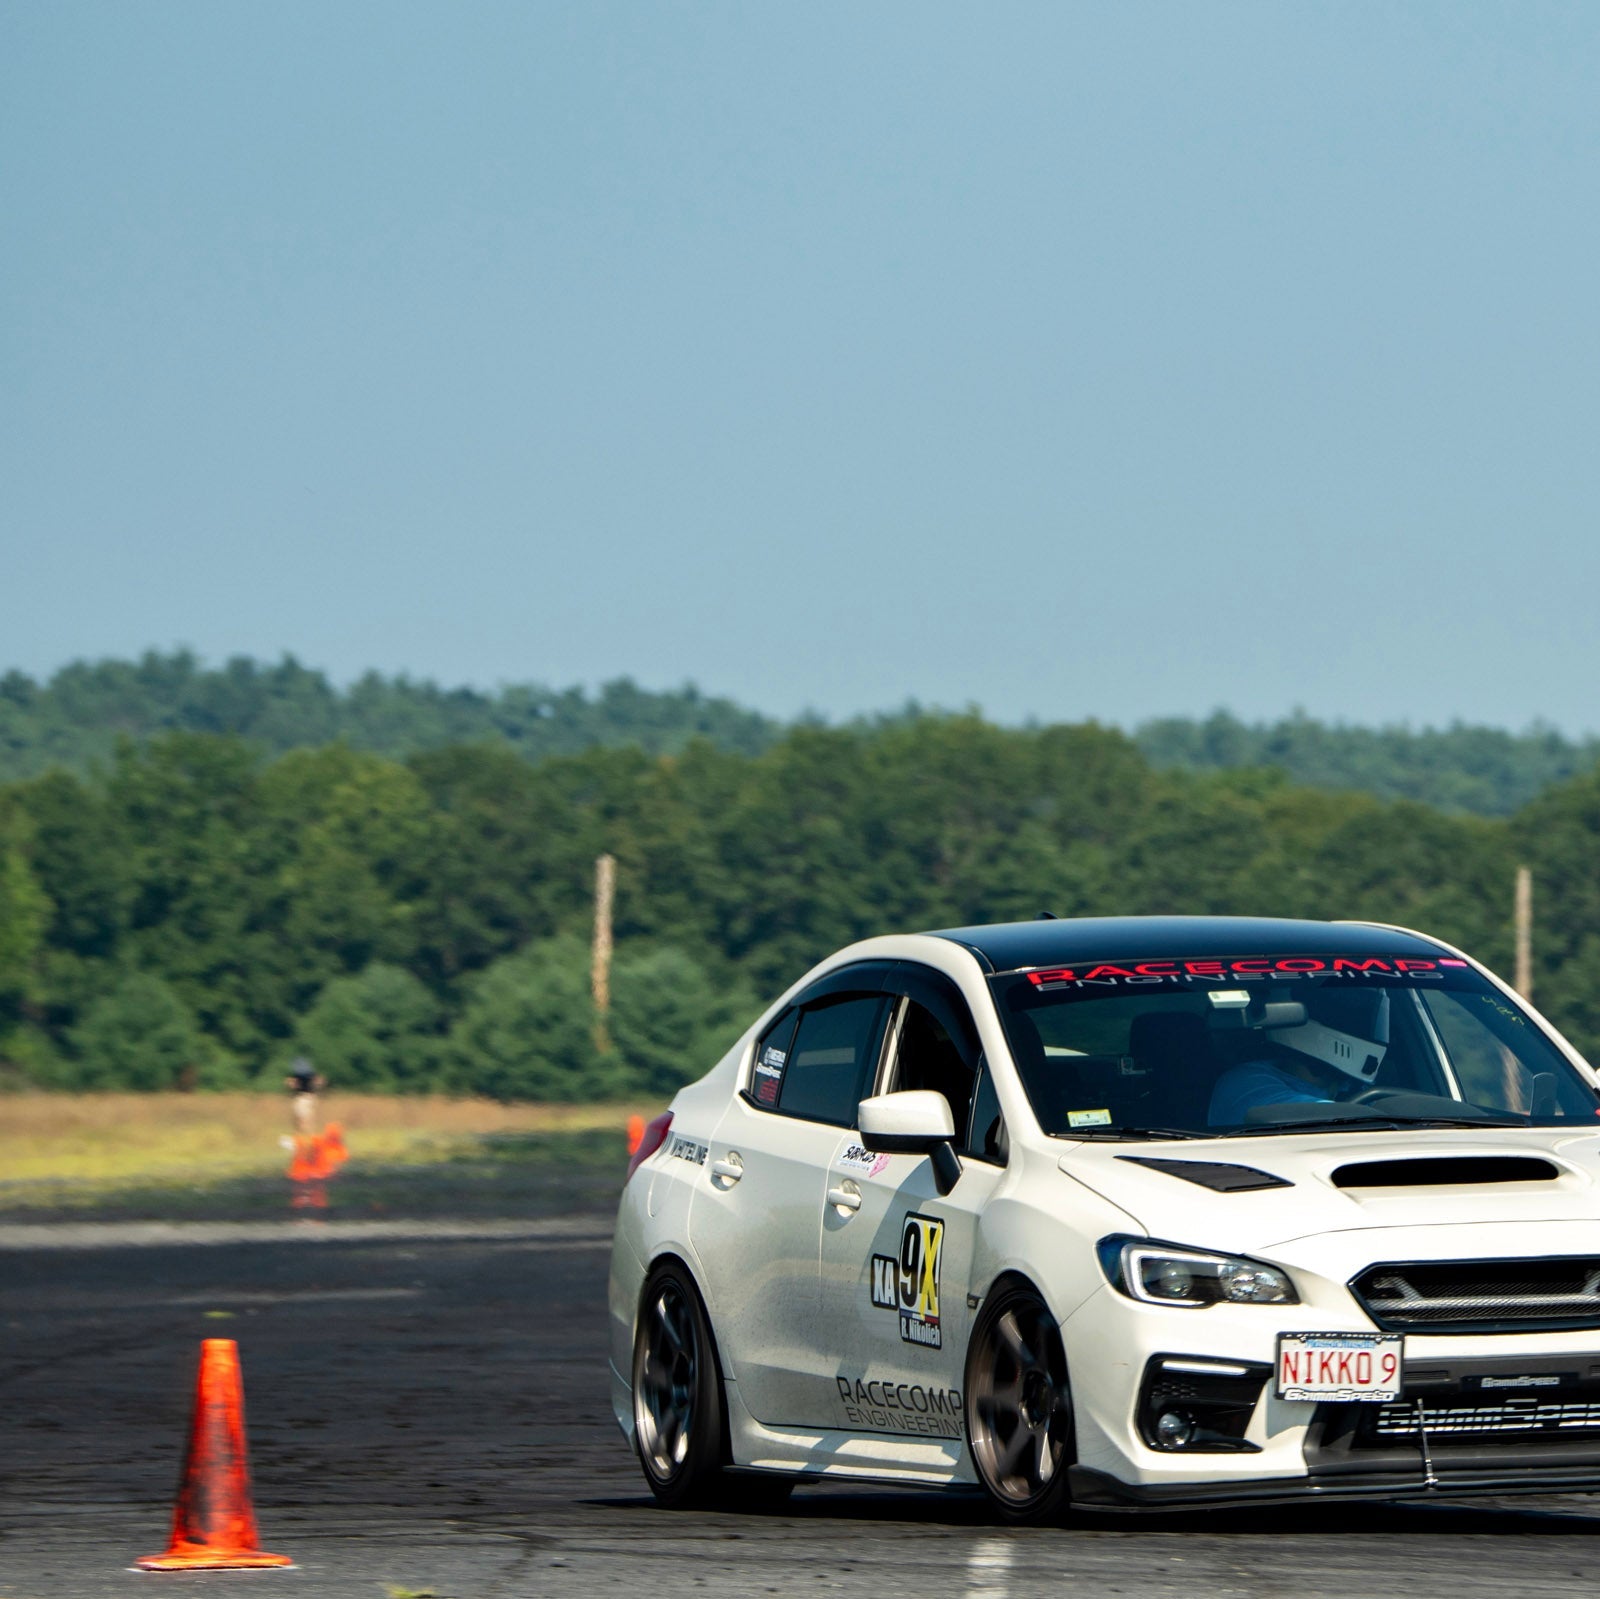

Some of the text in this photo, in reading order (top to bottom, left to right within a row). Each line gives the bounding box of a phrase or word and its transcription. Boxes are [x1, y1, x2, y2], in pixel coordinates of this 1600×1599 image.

[1027, 958, 1437, 985] RACECOMP
[1036, 970, 1444, 992] ENGINEERING
[873, 1258, 896, 1306] XA
[1381, 1353, 1397, 1384] 9
[836, 1376, 963, 1417] RACECOMP
